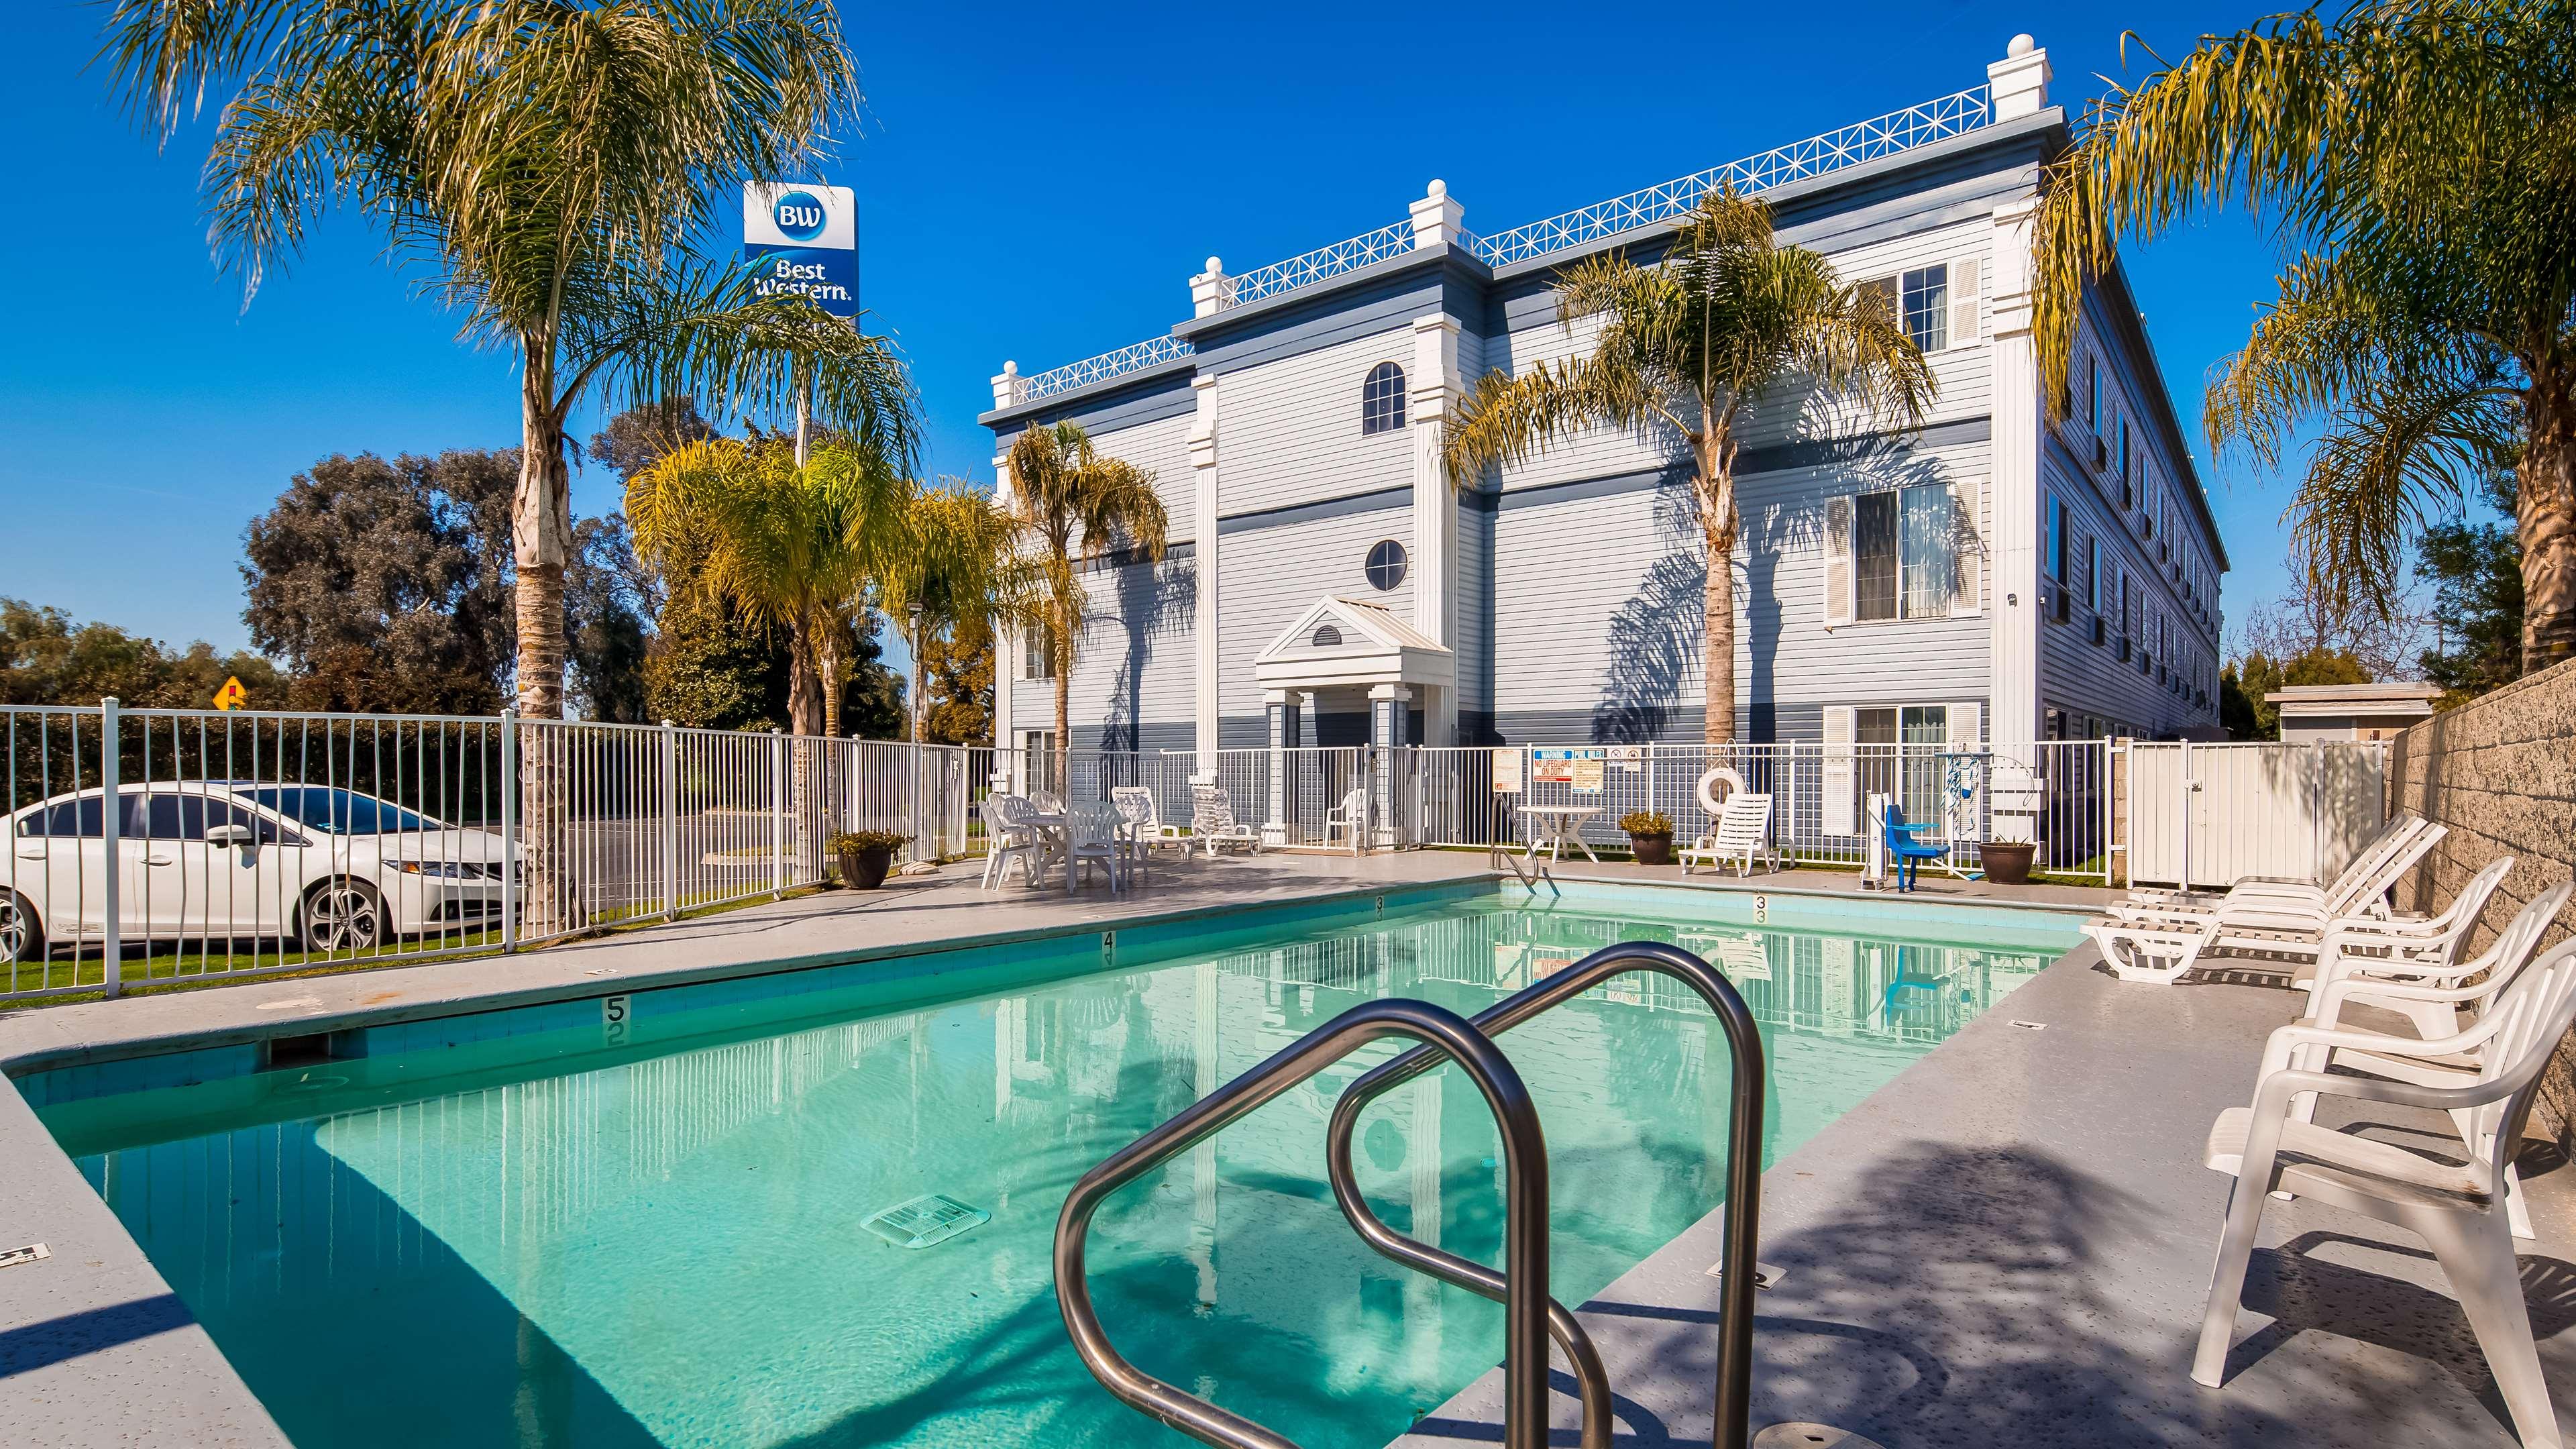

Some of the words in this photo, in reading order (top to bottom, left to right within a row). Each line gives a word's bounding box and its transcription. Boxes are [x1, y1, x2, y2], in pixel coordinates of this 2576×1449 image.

[780, 205, 820, 227] BW
[776, 259, 826, 280] Best
[1541, 751, 1566, 759] WARNING
[1534, 759, 1542, 767] NO
[1544, 759, 1572, 768] LIFEGUARD
[1377, 896, 1383, 910] 3
[1757, 896, 1765, 909] 3
[1104, 932, 1113, 949] 4
[608, 997, 624, 1022] 5
